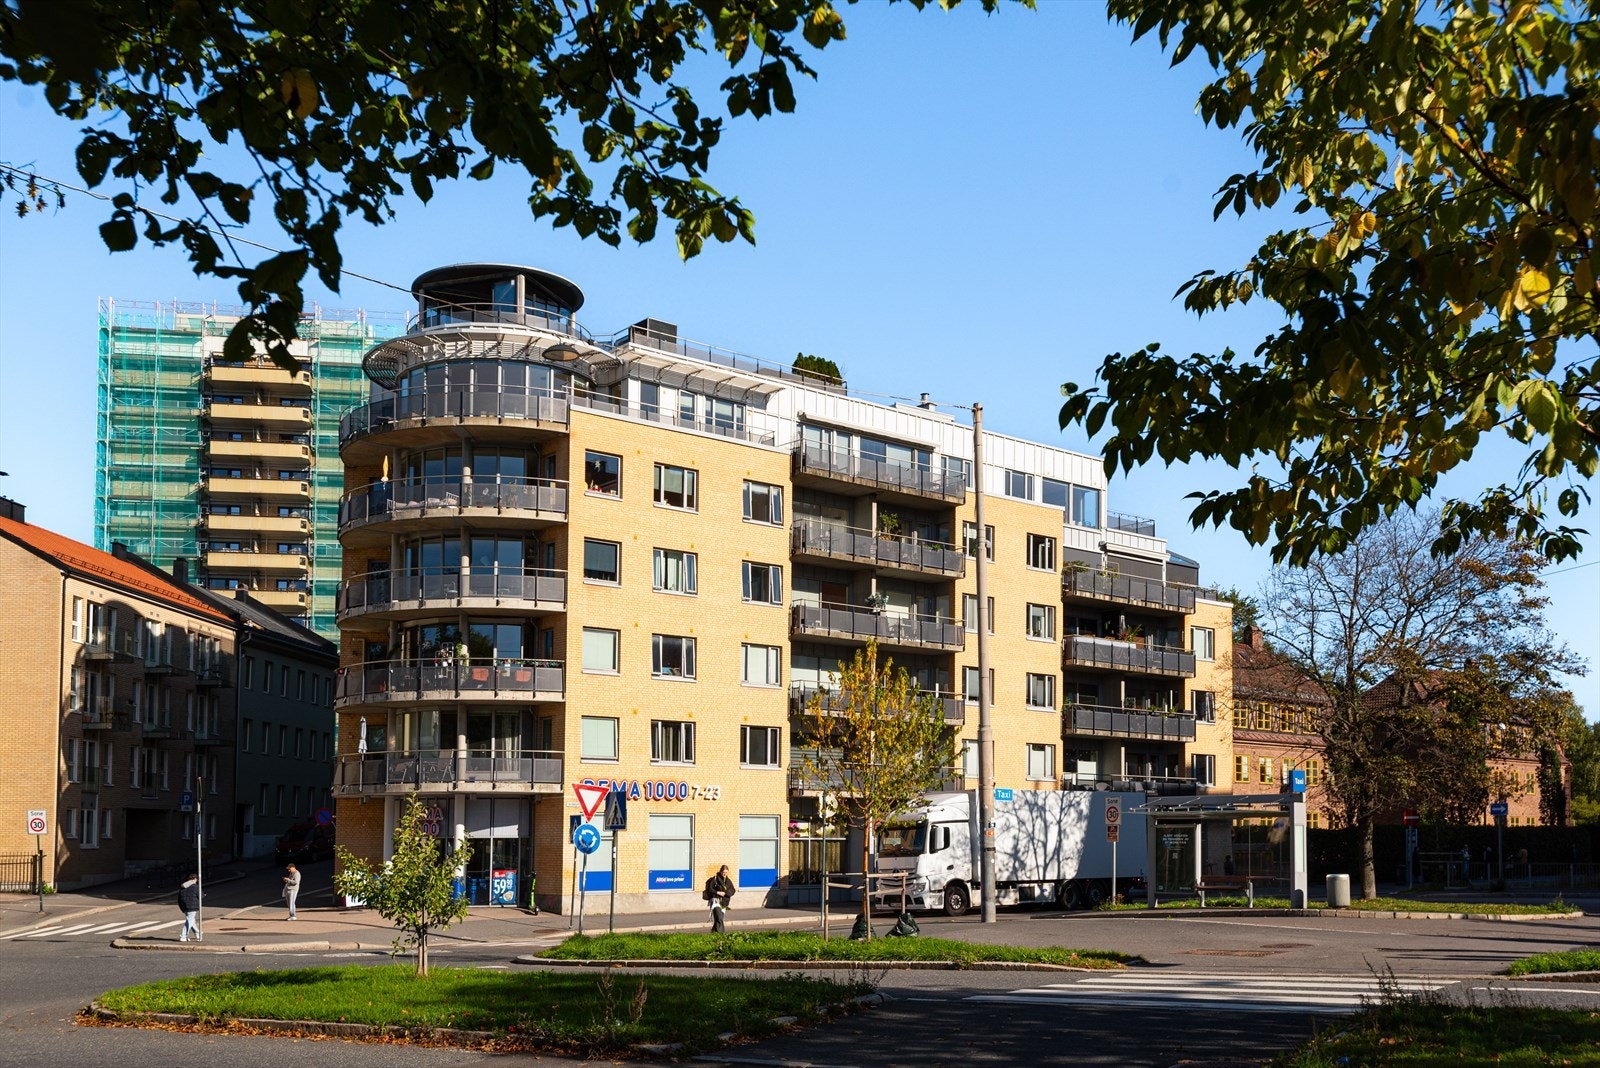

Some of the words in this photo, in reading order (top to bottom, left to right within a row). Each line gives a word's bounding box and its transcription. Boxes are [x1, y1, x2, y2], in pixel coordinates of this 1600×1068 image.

[645, 781, 690, 800] 1000
[691, 785, 721, 801] 7-23
[997, 790, 1011, 799] Taxi
[183, 794, 190, 804] P
[1108, 810, 1117, 819] 30
[33, 821, 43, 829] 30
[493, 879, 506, 894] 59
